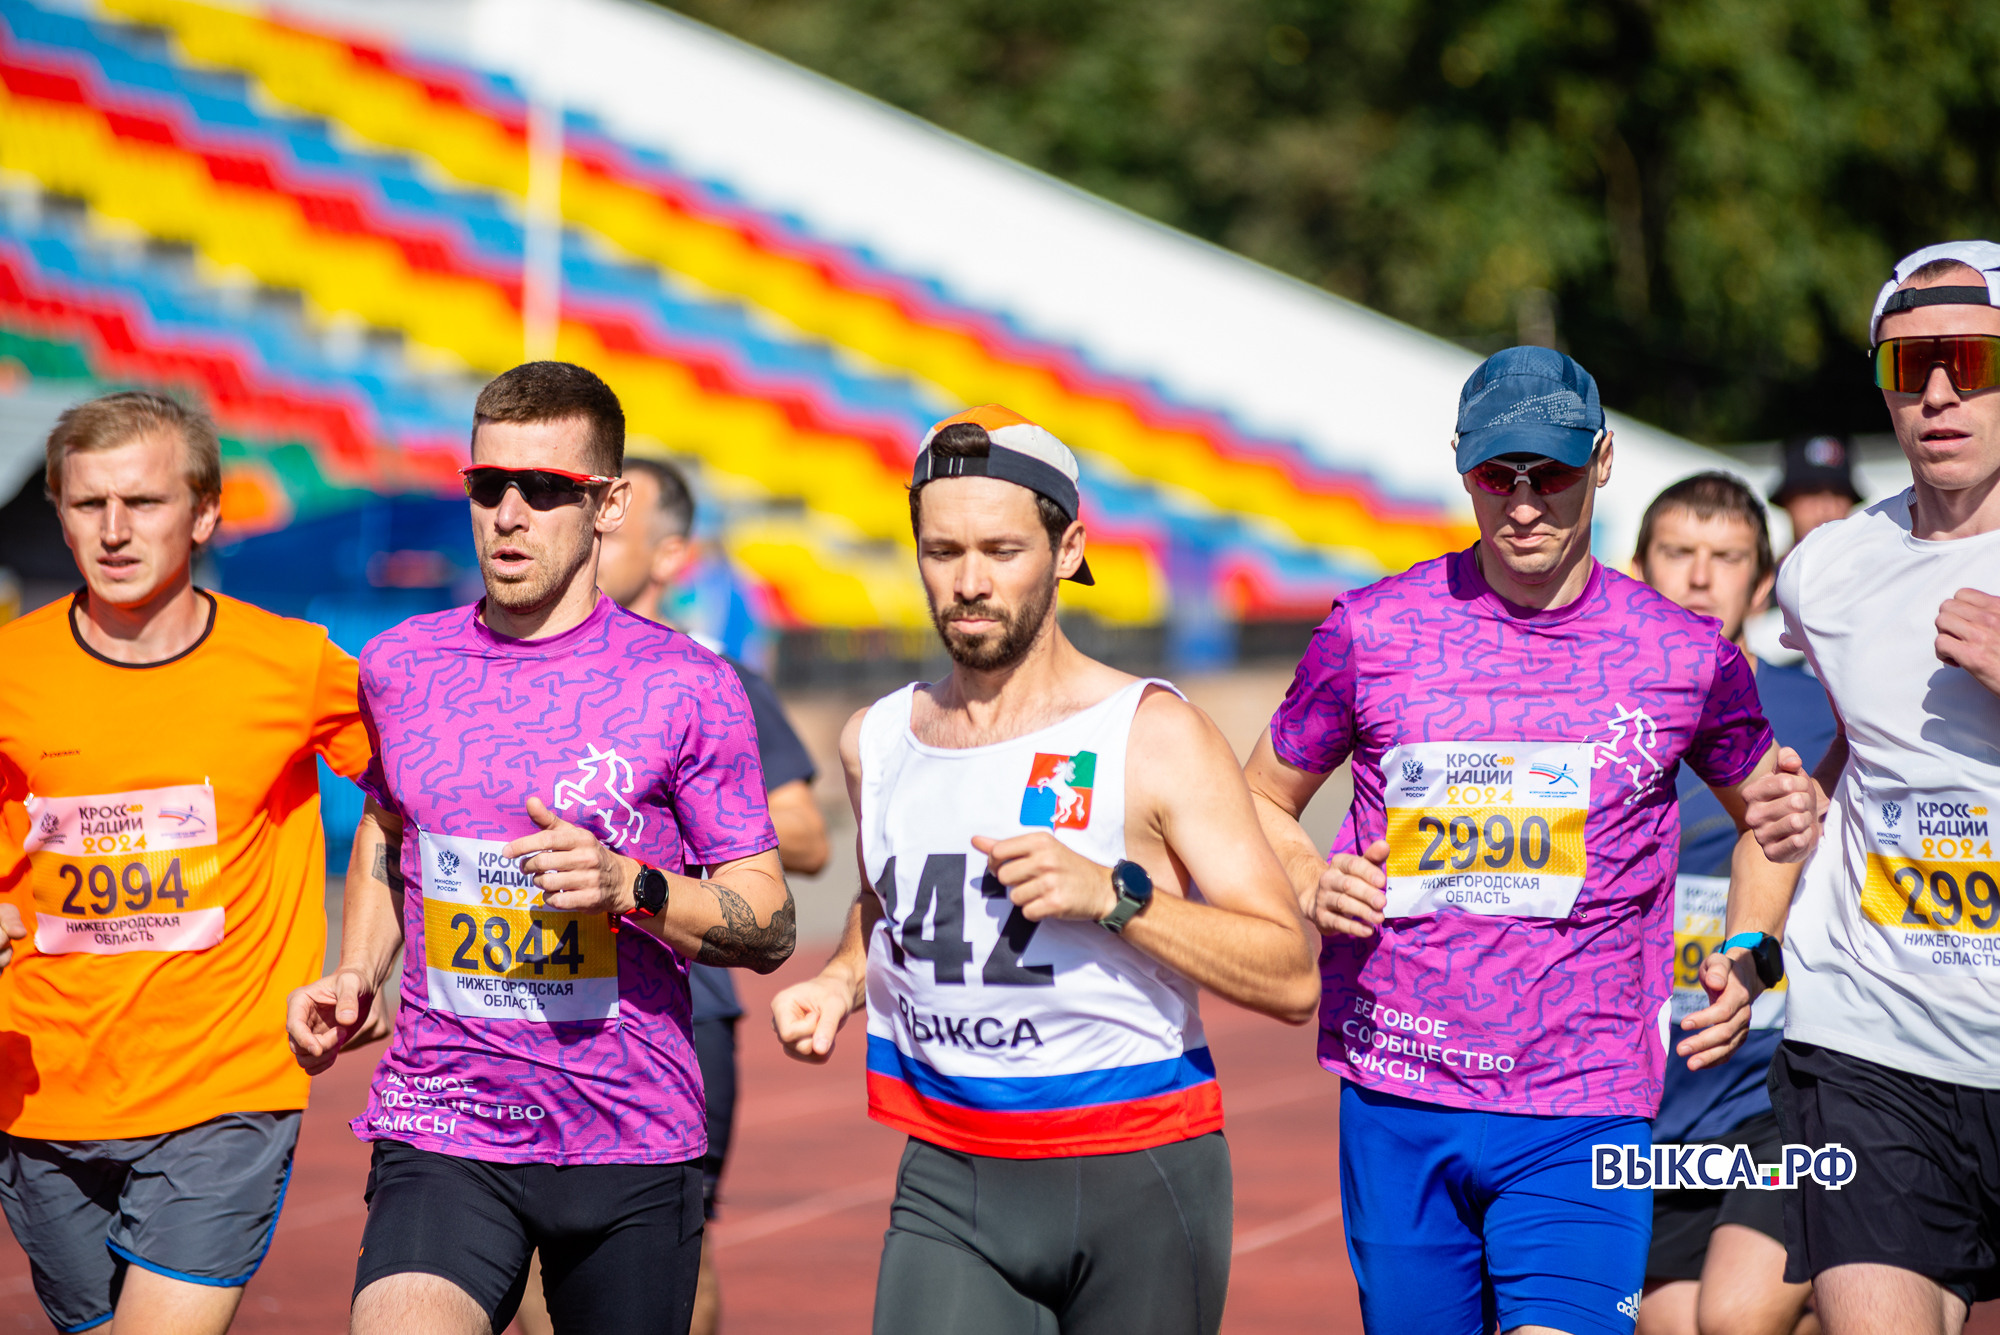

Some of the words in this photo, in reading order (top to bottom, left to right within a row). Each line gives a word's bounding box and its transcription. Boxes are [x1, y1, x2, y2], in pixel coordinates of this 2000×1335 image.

[1447, 753, 1498, 768] КРОСС
[1446, 770, 1513, 786] НАЦИИ
[1446, 786, 1514, 805] 2024
[79, 804, 128, 820] КРОСС
[1917, 802, 1971, 819] КРОСС
[81, 817, 144, 836] НАЦИИ
[1918, 820, 1988, 838] НАЦИИ
[82, 833, 148, 854] 2024
[1418, 815, 1551, 871] 2990
[1921, 838, 1993, 859] 2024
[60, 858, 189, 915] 2994
[1420, 875, 1540, 891] НИЖЕГОРОДСКАЯ
[480, 885, 546, 909] 2024
[1445, 890, 1511, 904] ОБЛАСТЬ
[66, 915, 181, 933] НИЖЕГОРОДСКАЯ
[94, 930, 154, 946] ОБЛАСТЬ
[450, 913, 584, 975] 2844
[456, 976, 574, 996] НИЖЕГОРОДСКАЯ
[483, 993, 546, 1011] ОБЛАСТЬ
[898, 993, 1044, 1051] ВЫКСА
[1354, 996, 1449, 1039] БЕГОВОЕ
[1342, 1020, 1515, 1073] СООБЩЕСТВО
